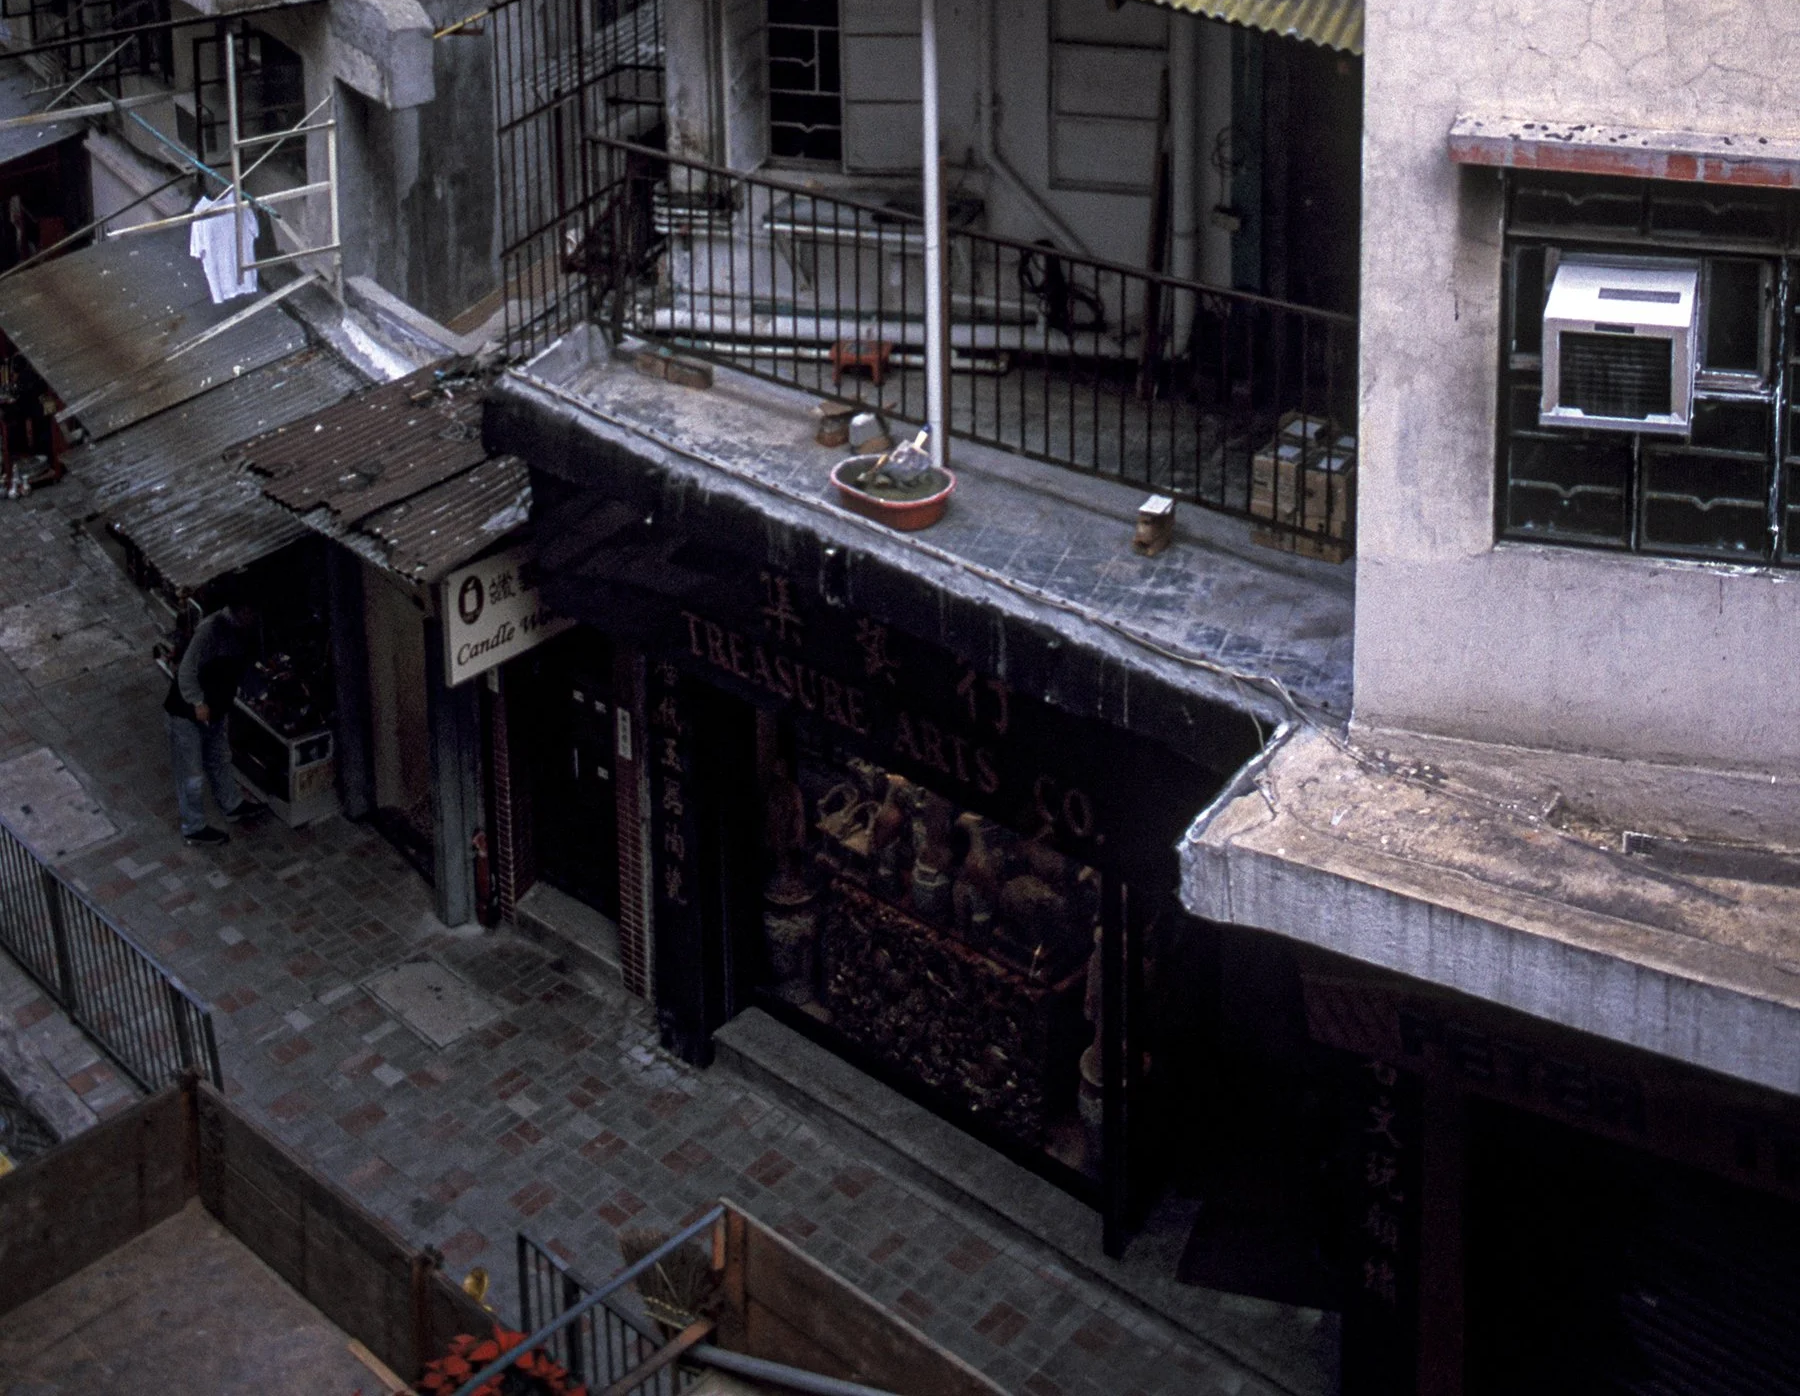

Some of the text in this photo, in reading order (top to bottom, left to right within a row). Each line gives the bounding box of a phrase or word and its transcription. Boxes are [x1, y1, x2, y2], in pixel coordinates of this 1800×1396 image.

[457, 621, 516, 666] Candle
[680, 608, 868, 737] TREASURE
[898, 710, 1001, 795] ARTS
